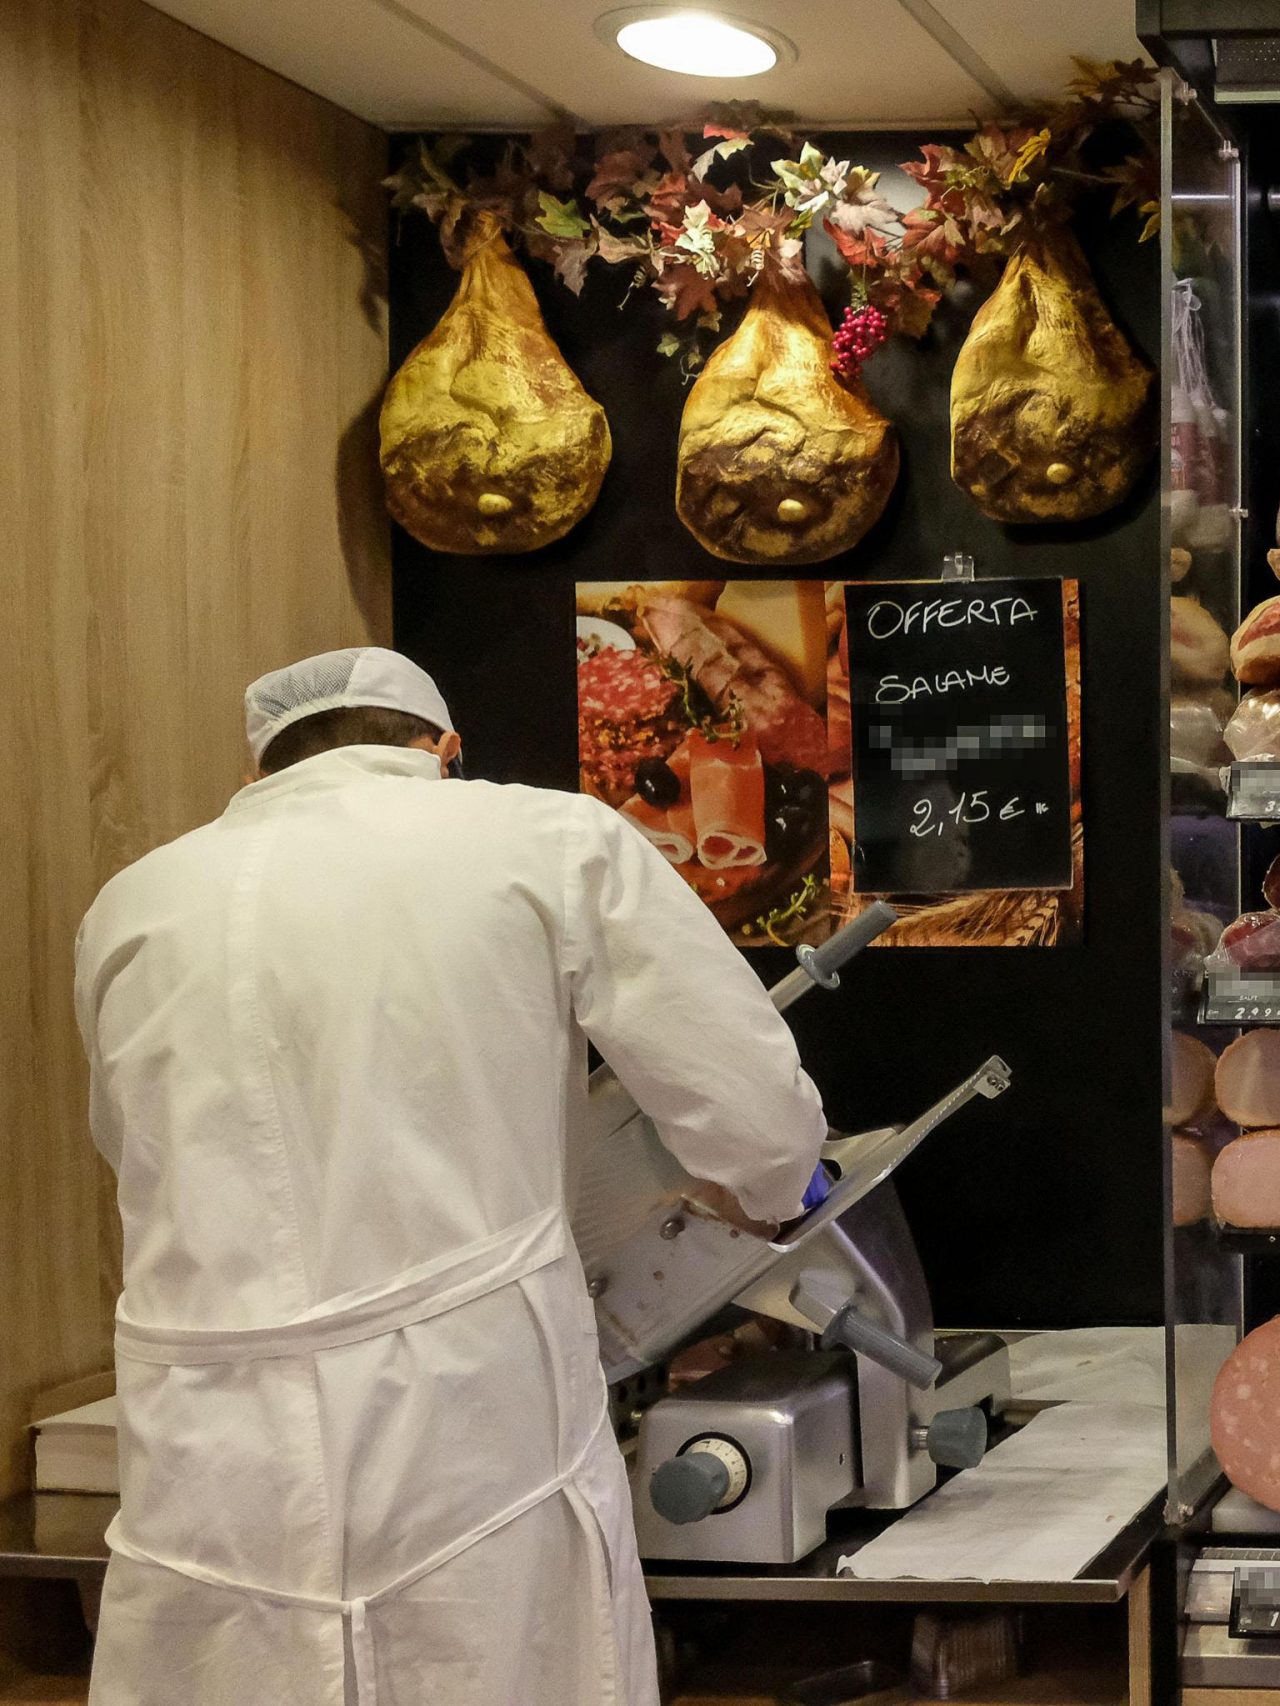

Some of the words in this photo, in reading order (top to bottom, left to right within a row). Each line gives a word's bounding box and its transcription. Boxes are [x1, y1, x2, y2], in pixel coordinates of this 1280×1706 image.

[867, 597, 1038, 639] OFFERTA
[875, 665, 1010, 704] SALAME
[909, 790, 990, 838] 2,15
